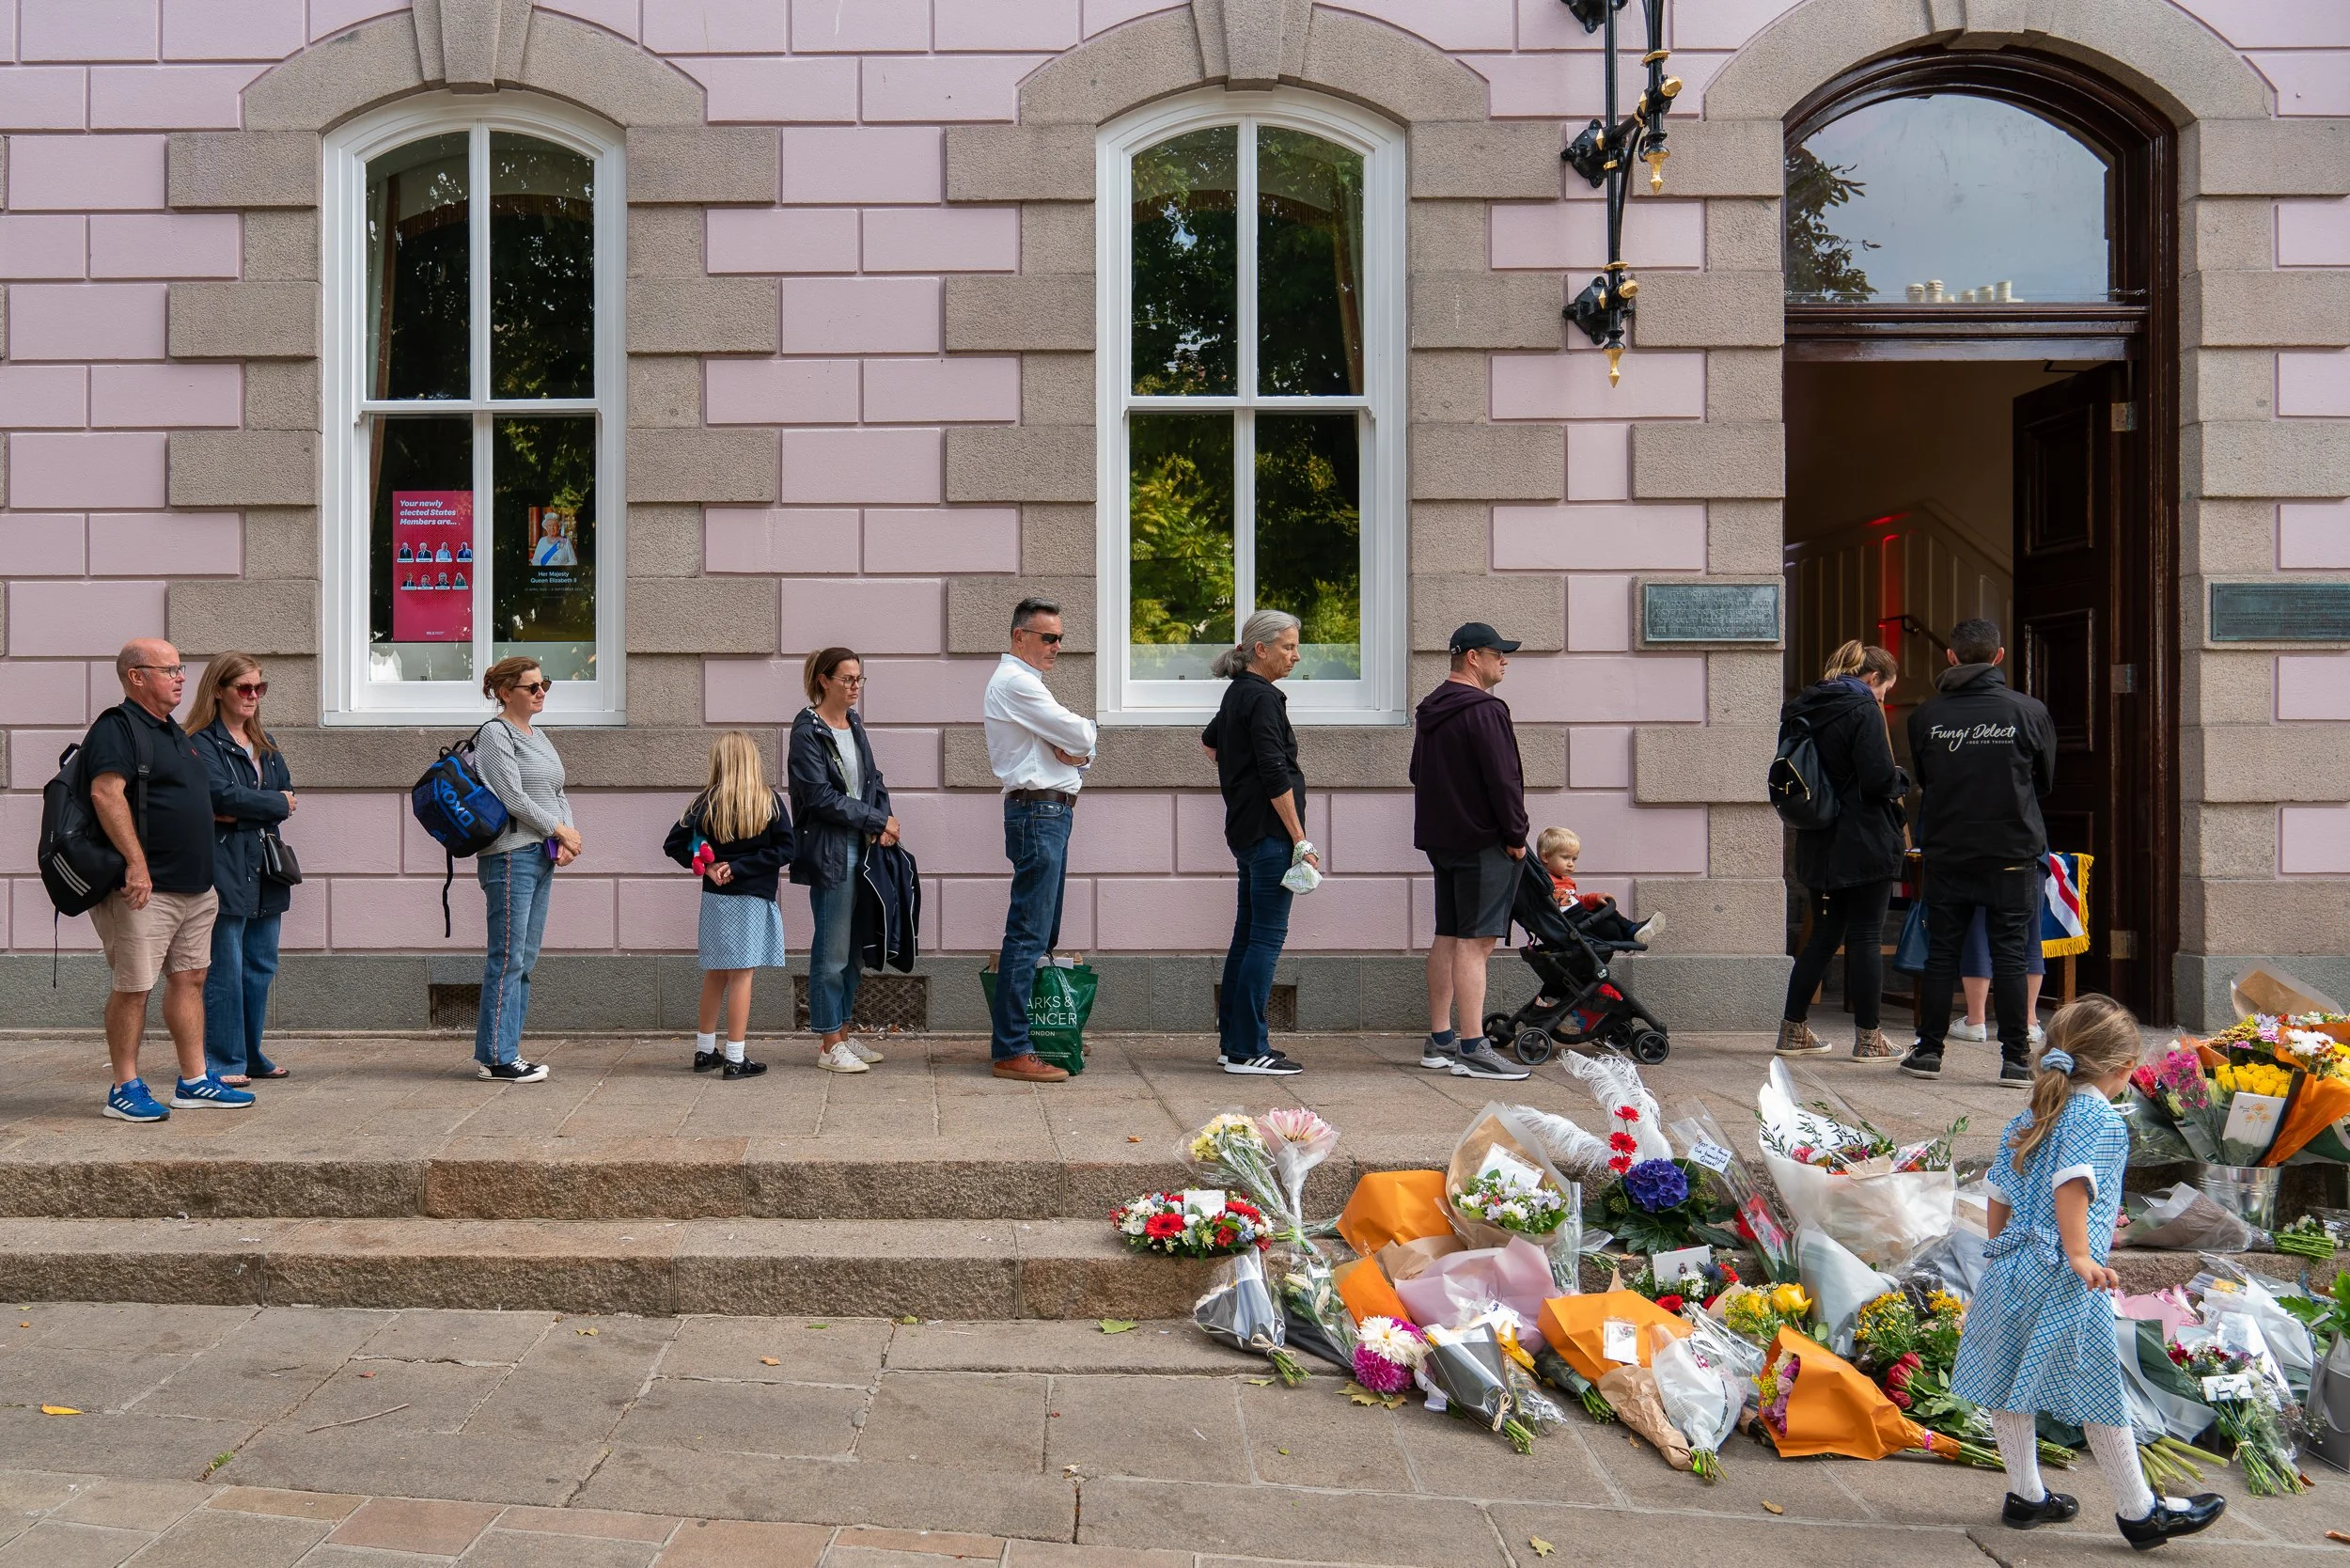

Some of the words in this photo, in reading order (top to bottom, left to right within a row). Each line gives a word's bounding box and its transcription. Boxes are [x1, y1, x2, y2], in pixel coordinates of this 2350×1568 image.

[1930, 724, 1970, 752] Fungi
[1972, 723, 2016, 739] Delecti
[1026, 996, 1061, 1009] ARKS
[1063, 996, 1073, 1008] &
[1026, 1012, 1077, 1026] ENCER
